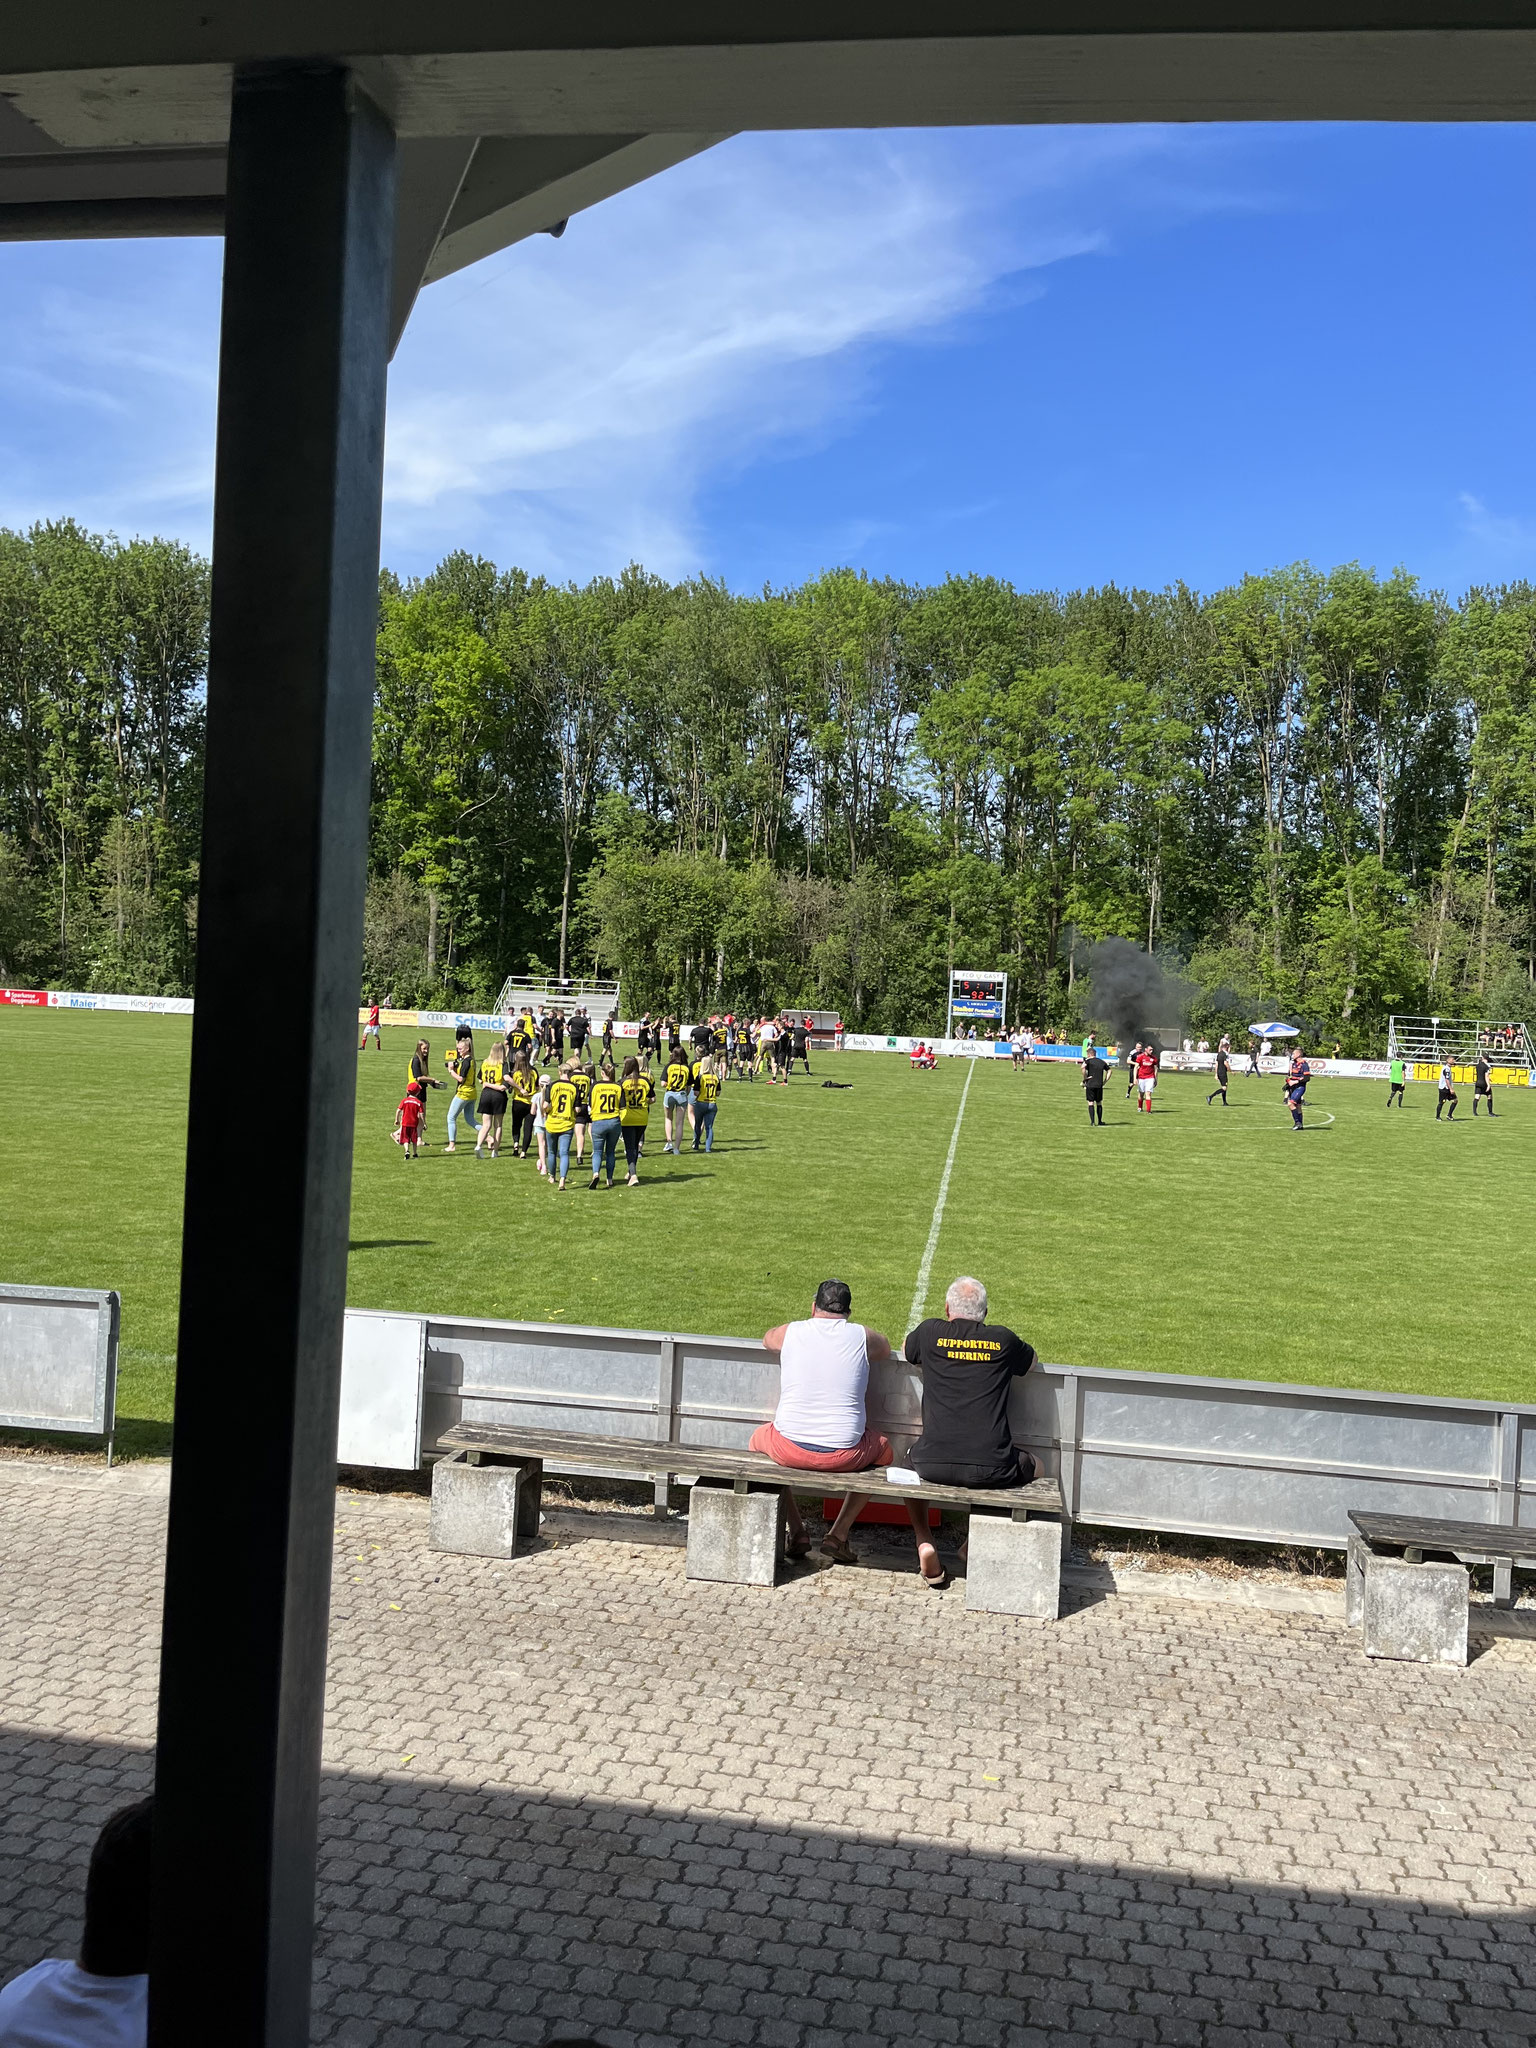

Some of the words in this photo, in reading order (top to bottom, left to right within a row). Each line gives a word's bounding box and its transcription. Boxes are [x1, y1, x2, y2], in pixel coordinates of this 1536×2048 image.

[963, 981, 970, 990] 5
[10, 997, 40, 1005] Deggendorf
[11, 992, 36, 1000] Sparkasse
[70, 999, 98, 1008] Maier
[455, 1014, 506, 1030] Scheick
[513, 1035, 523, 1049] 17
[484, 1069, 496, 1085] 18
[671, 1073, 685, 1090] 22
[628, 1089, 644, 1107] 32
[705, 1083, 715, 1099] 17
[557, 1093, 567, 1114] 6
[600, 1093, 616, 1114] 20
[936, 1338, 1001, 1350] SUPPORTERS
[947, 1350, 991, 1361] RIERING
